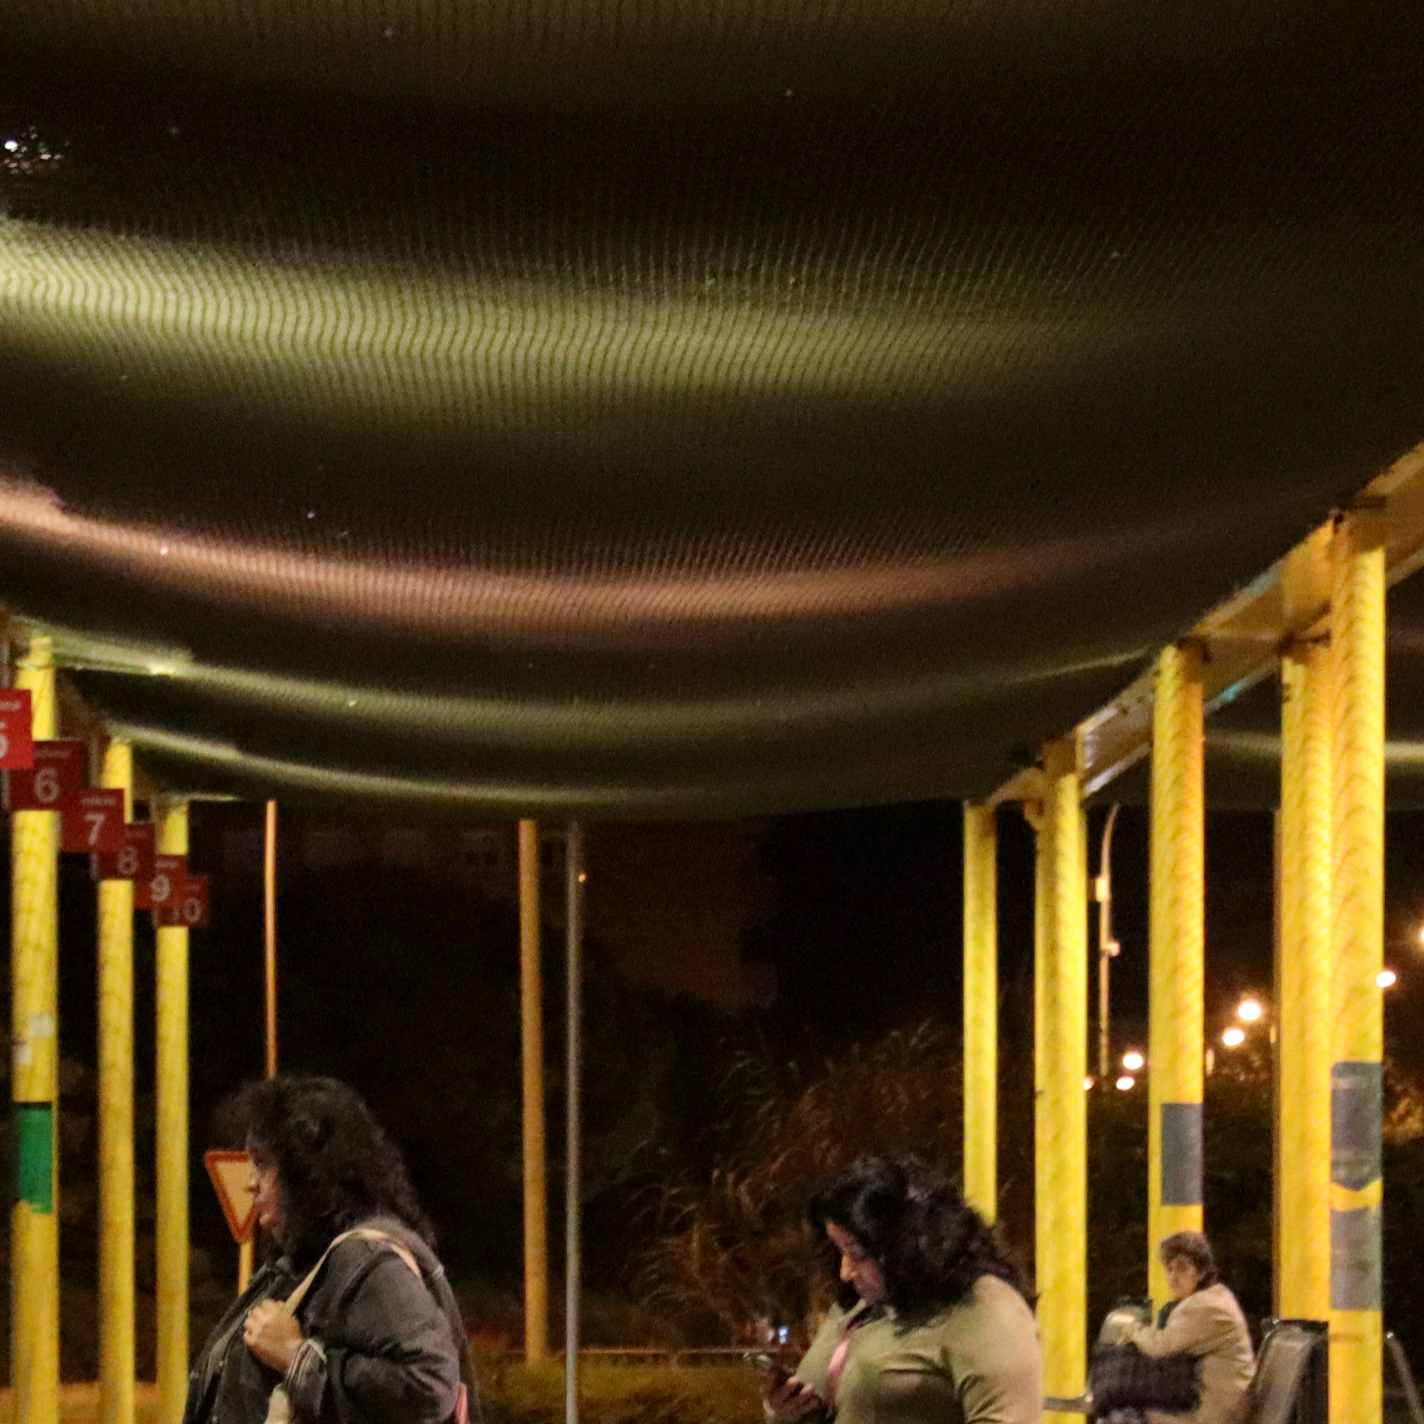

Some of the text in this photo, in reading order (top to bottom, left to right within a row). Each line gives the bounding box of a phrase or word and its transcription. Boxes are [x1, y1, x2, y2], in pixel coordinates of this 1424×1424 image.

[34, 767, 59, 803] 6
[84, 813, 106, 845] 7
[117, 847, 140, 875] 8
[150, 875, 170, 902] 9
